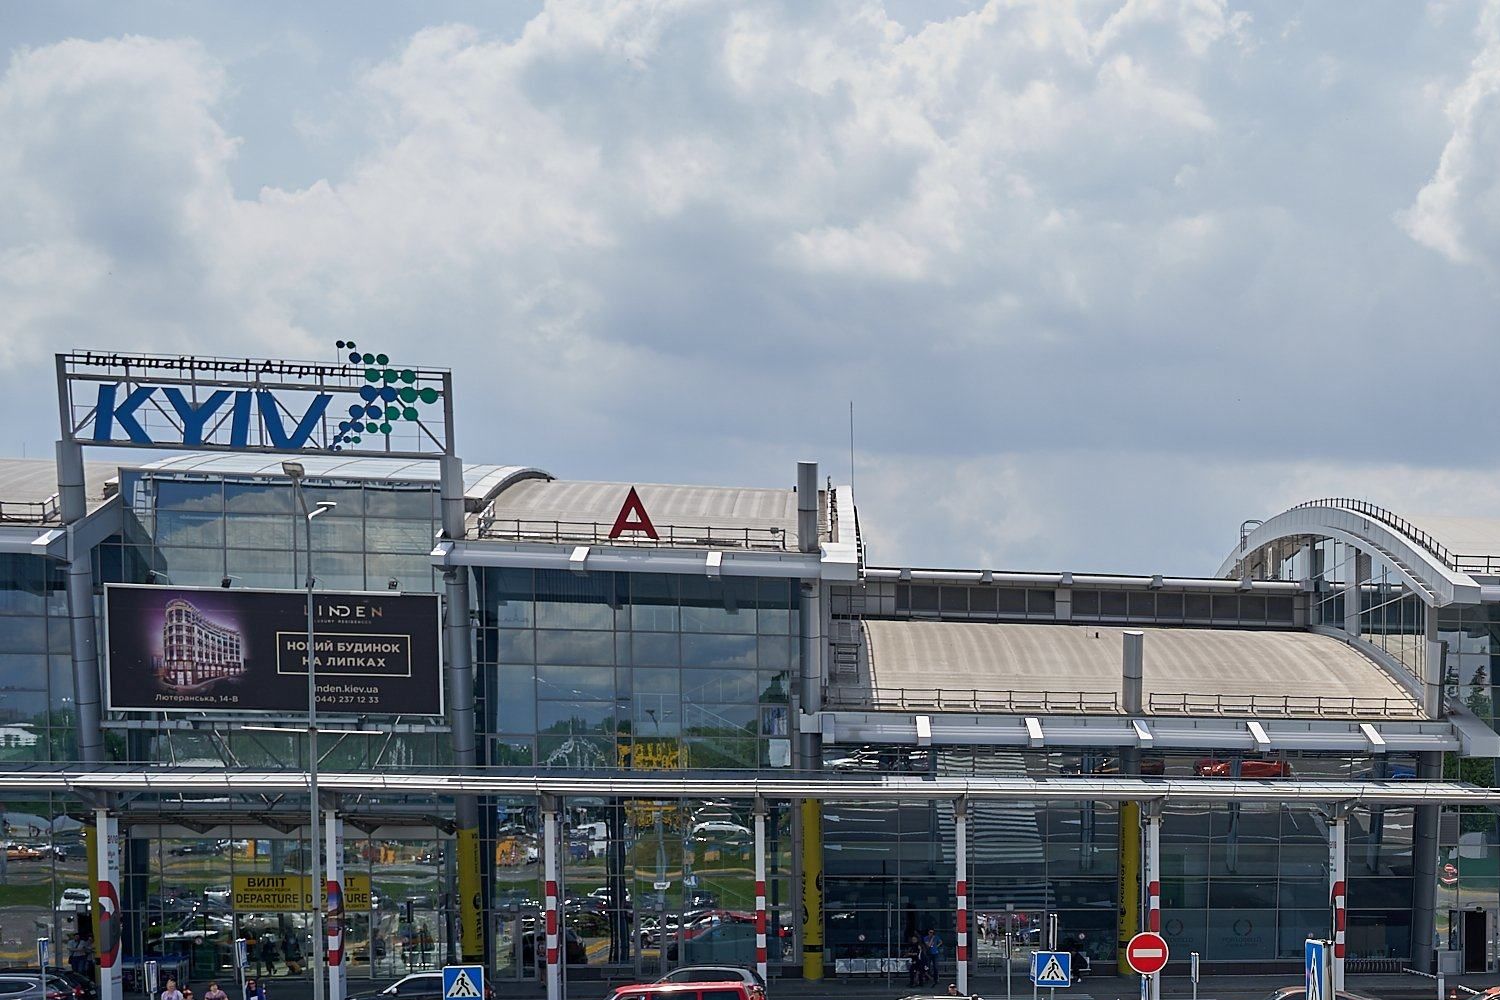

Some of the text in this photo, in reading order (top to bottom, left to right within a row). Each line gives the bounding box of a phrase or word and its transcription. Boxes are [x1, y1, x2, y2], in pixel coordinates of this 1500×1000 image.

[85, 351, 348, 379] International Airport
[93, 383, 335, 450] KYIV
[608, 485, 660, 541] A
[303, 605, 383, 618] LINDEN
[337, 642, 400, 654] БУДИНОК
[326, 657, 386, 668] ЛИПКАХ
[314, 684, 379, 694] inden.kiev.ua
[155, 693, 217, 703] Лютеранська,
[314, 695, 379, 704] 044) 237 12 33
[247, 877, 287, 887] ВИЛІТ
[236, 893, 299, 904] DEPARTURE
